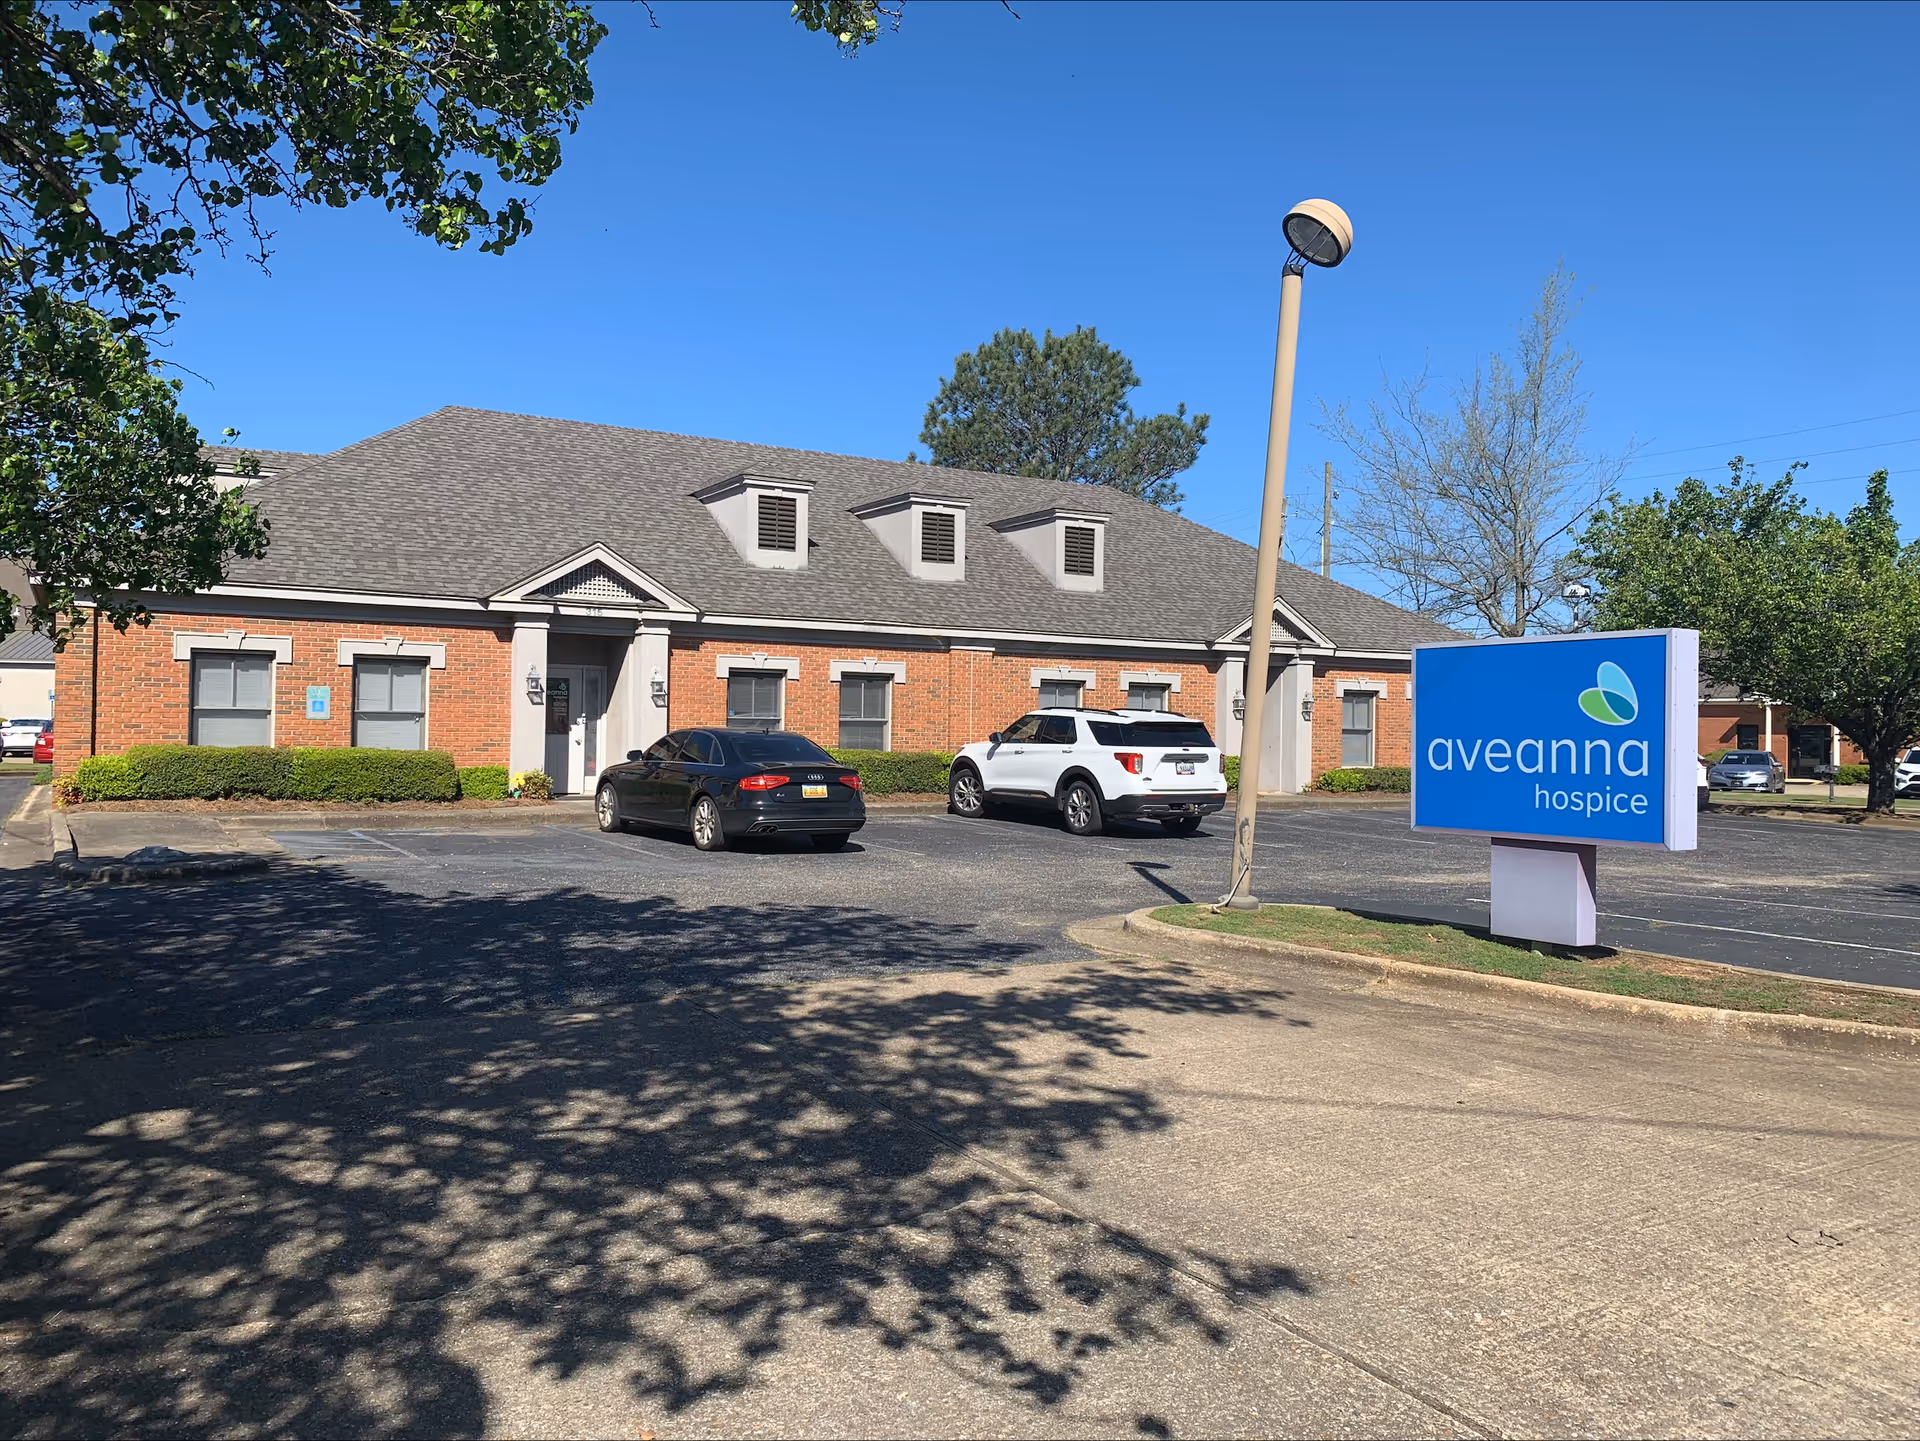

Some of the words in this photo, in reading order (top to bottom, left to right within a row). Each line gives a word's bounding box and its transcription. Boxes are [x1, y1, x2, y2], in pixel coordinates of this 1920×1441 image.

[585, 607, 603, 616] 315
[1427, 738, 1649, 777] aveanna
[1535, 783, 1648, 818] hospice
